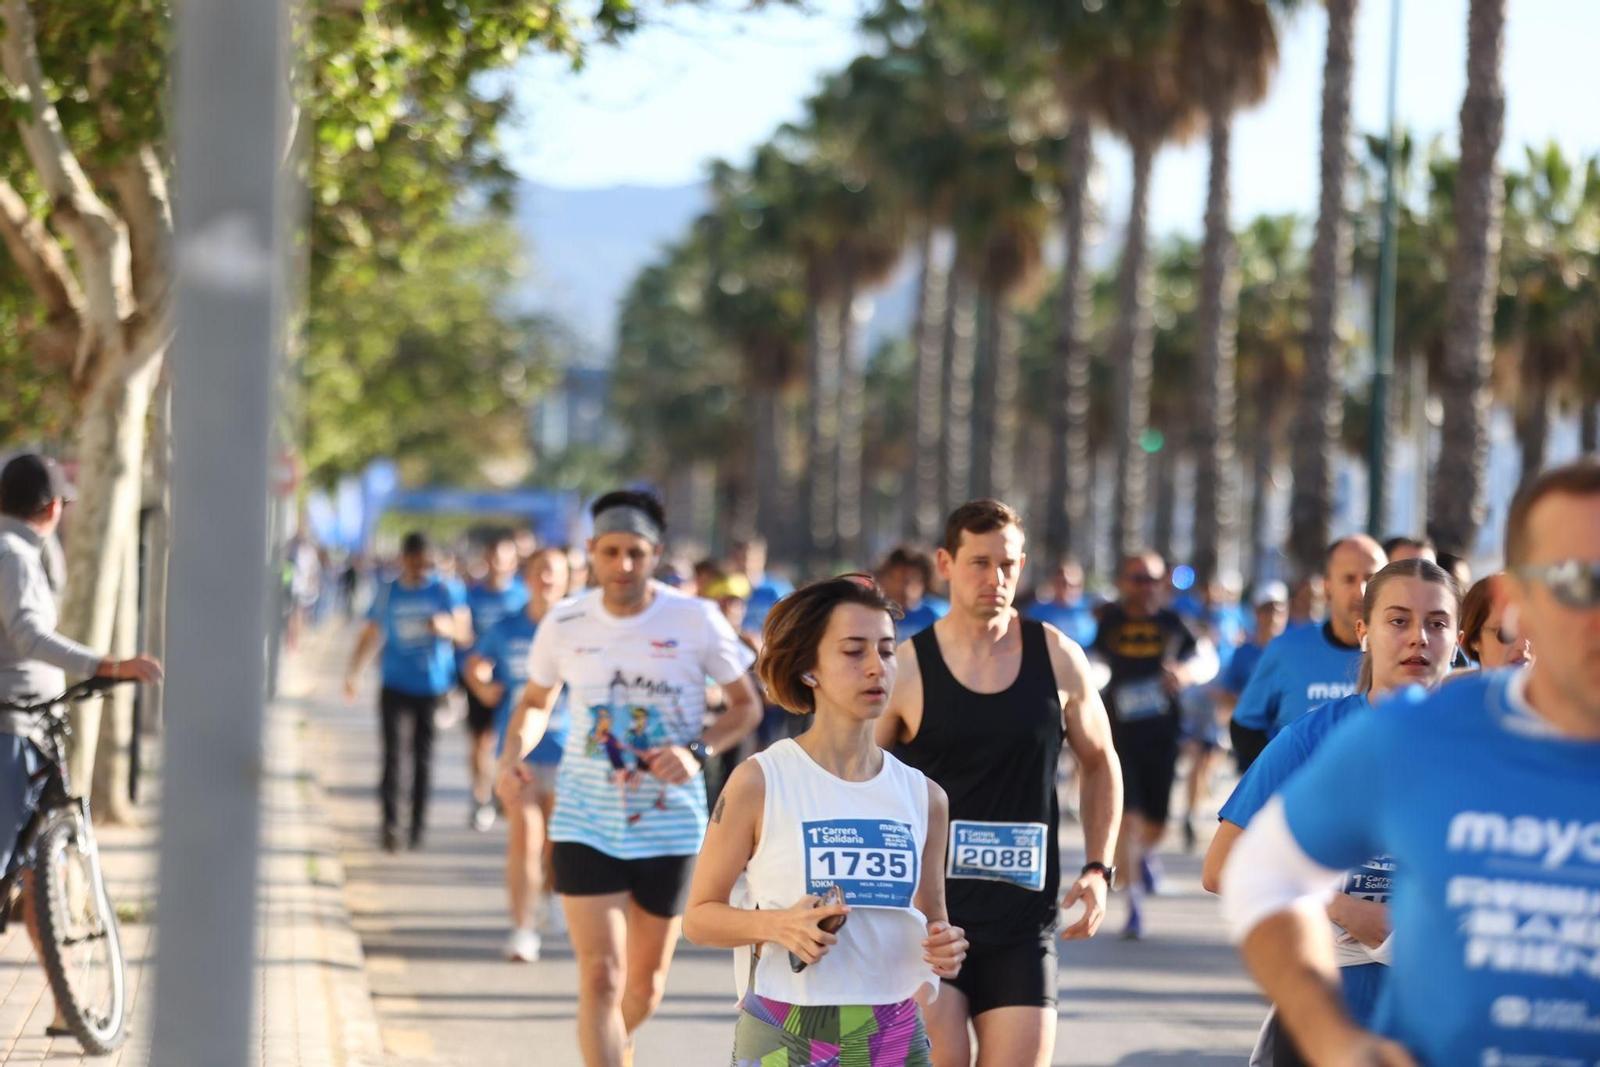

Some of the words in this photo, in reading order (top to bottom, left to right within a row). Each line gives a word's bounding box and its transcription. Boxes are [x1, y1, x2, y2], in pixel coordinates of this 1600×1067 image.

[822, 827, 857, 835] Carrera
[822, 835, 864, 844] Solidaria
[963, 848, 1032, 867] 2088
[818, 851, 907, 877] 1735
[811, 880, 834, 888] 10KM
